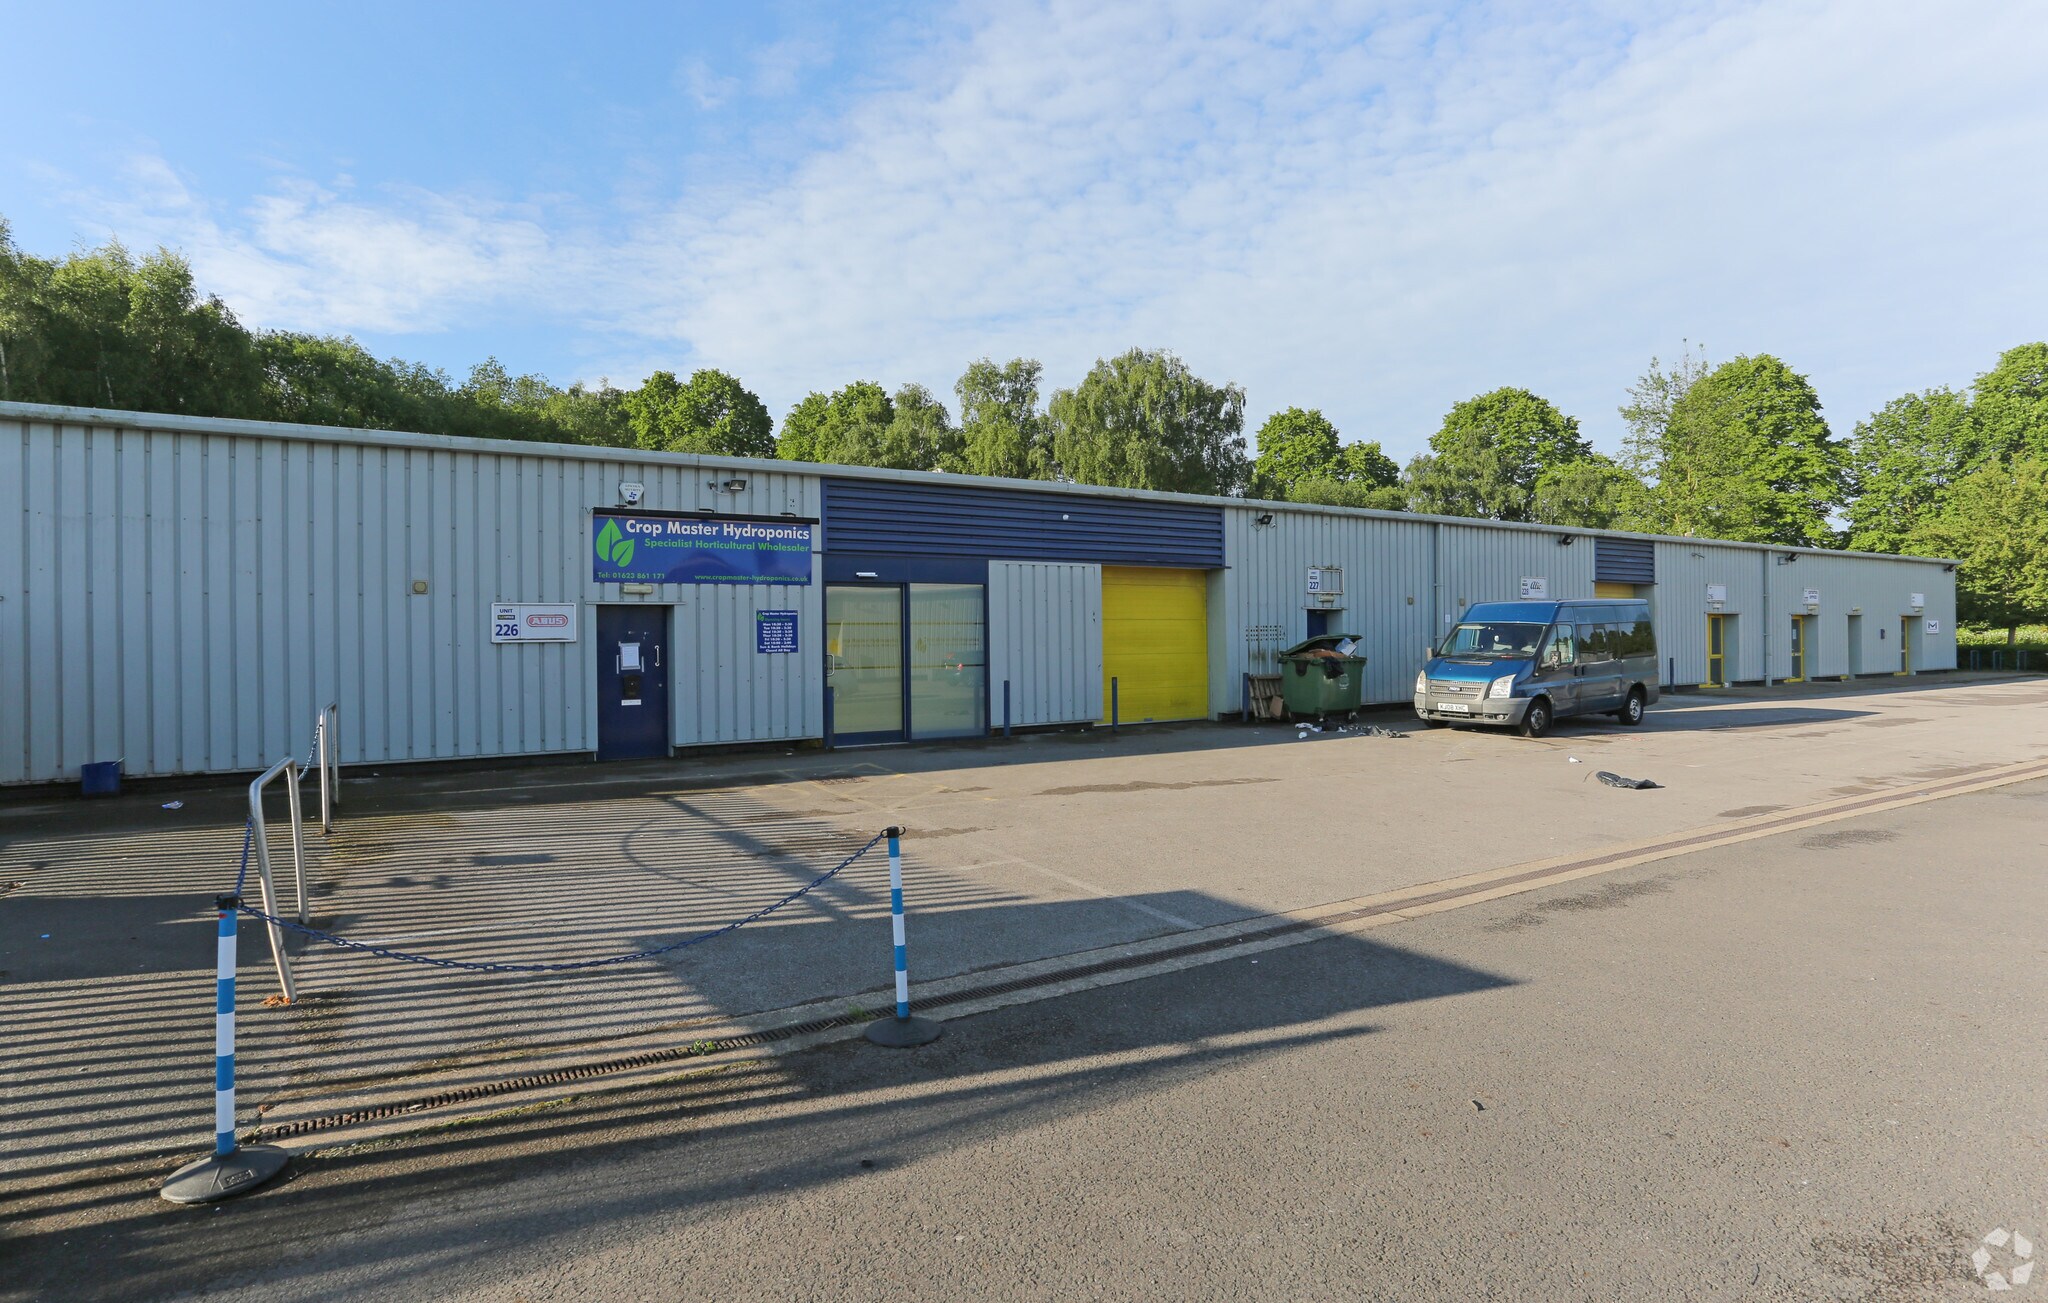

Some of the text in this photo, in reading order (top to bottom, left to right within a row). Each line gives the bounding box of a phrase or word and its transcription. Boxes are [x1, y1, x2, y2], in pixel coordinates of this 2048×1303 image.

[625, 519, 810, 540] Crop Master Hydroponics
[644, 538, 810, 552] Specialist Horticultural Wholesaler
[597, 571, 611, 579] Tel:
[636, 572, 652, 580] 861
[694, 574, 809, 583] www.cropmaster-hydroponics.co.uk
[532, 617, 563, 626] ABUS
[495, 624, 519, 637] 226
